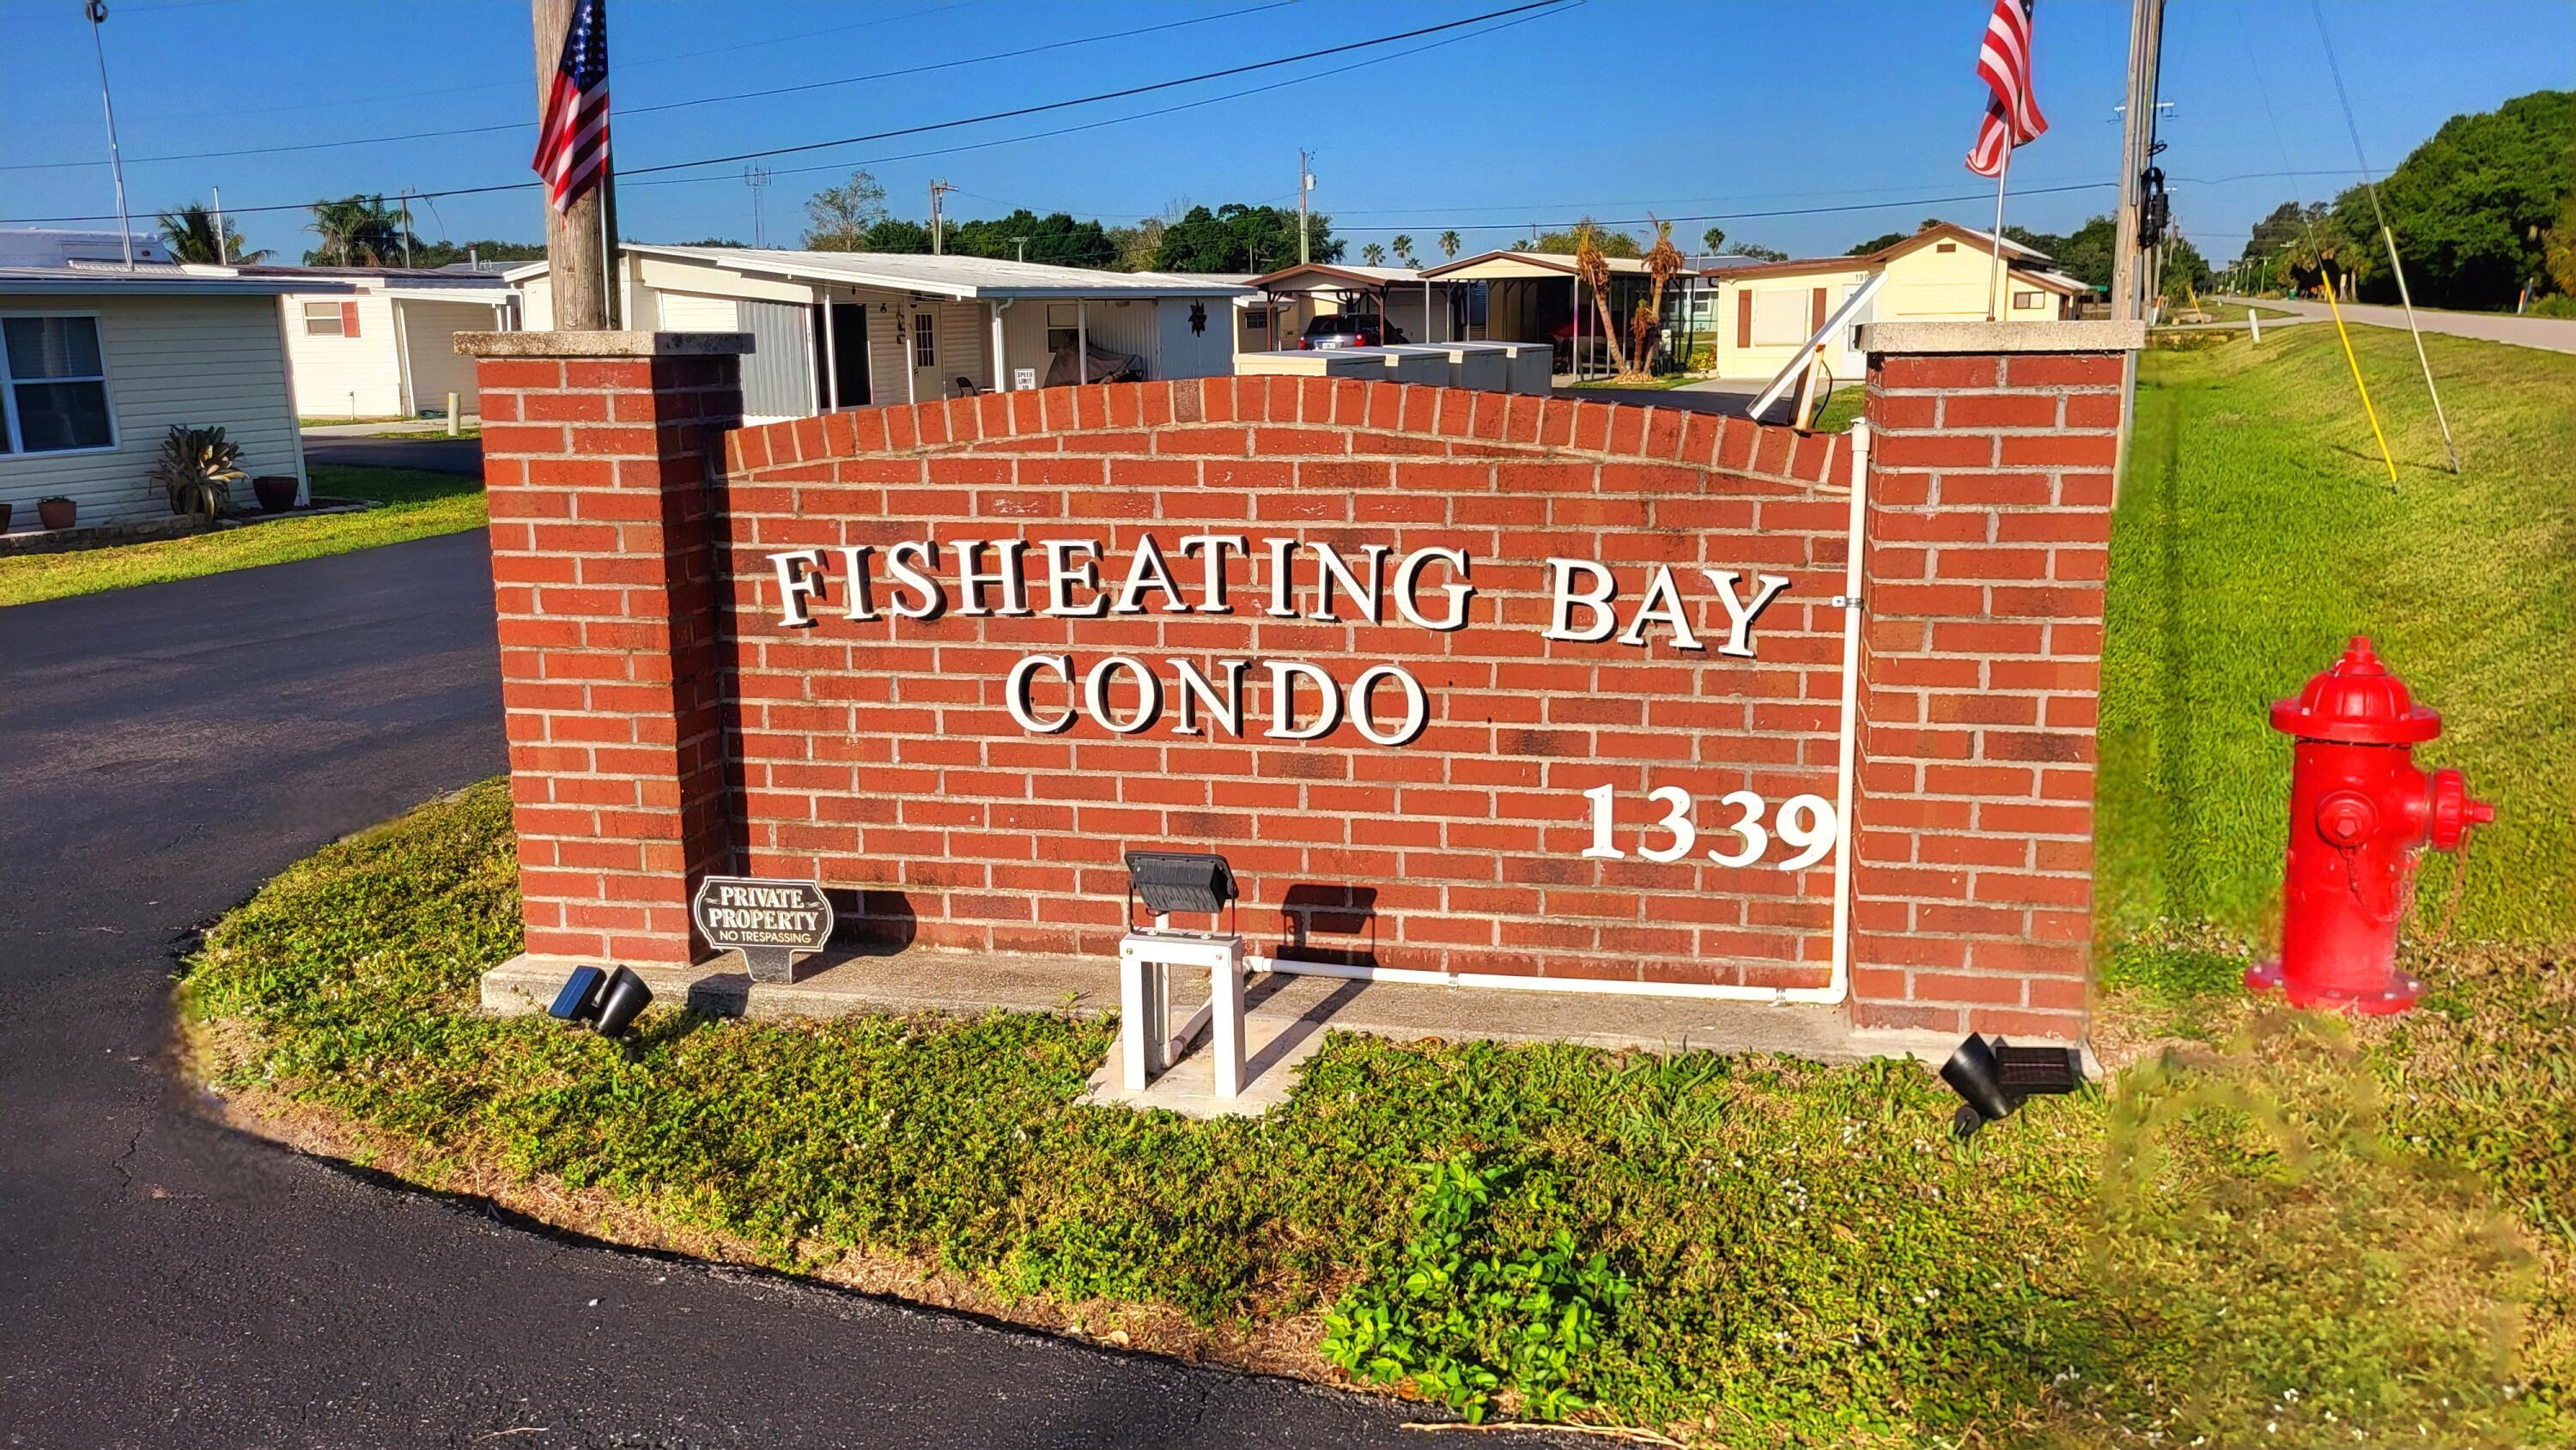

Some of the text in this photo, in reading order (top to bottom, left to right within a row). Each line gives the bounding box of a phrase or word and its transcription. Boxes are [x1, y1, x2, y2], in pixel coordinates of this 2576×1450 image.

[766, 532, 1791, 658] FISHEATING BAY
[1005, 654, 1430, 747] CONDO
[1581, 783, 1838, 871] 1339
[708, 907, 818, 931] PROPERTY
[720, 886, 805, 908] PRIVATE
[720, 930, 811, 943] NO TRESPASSING
